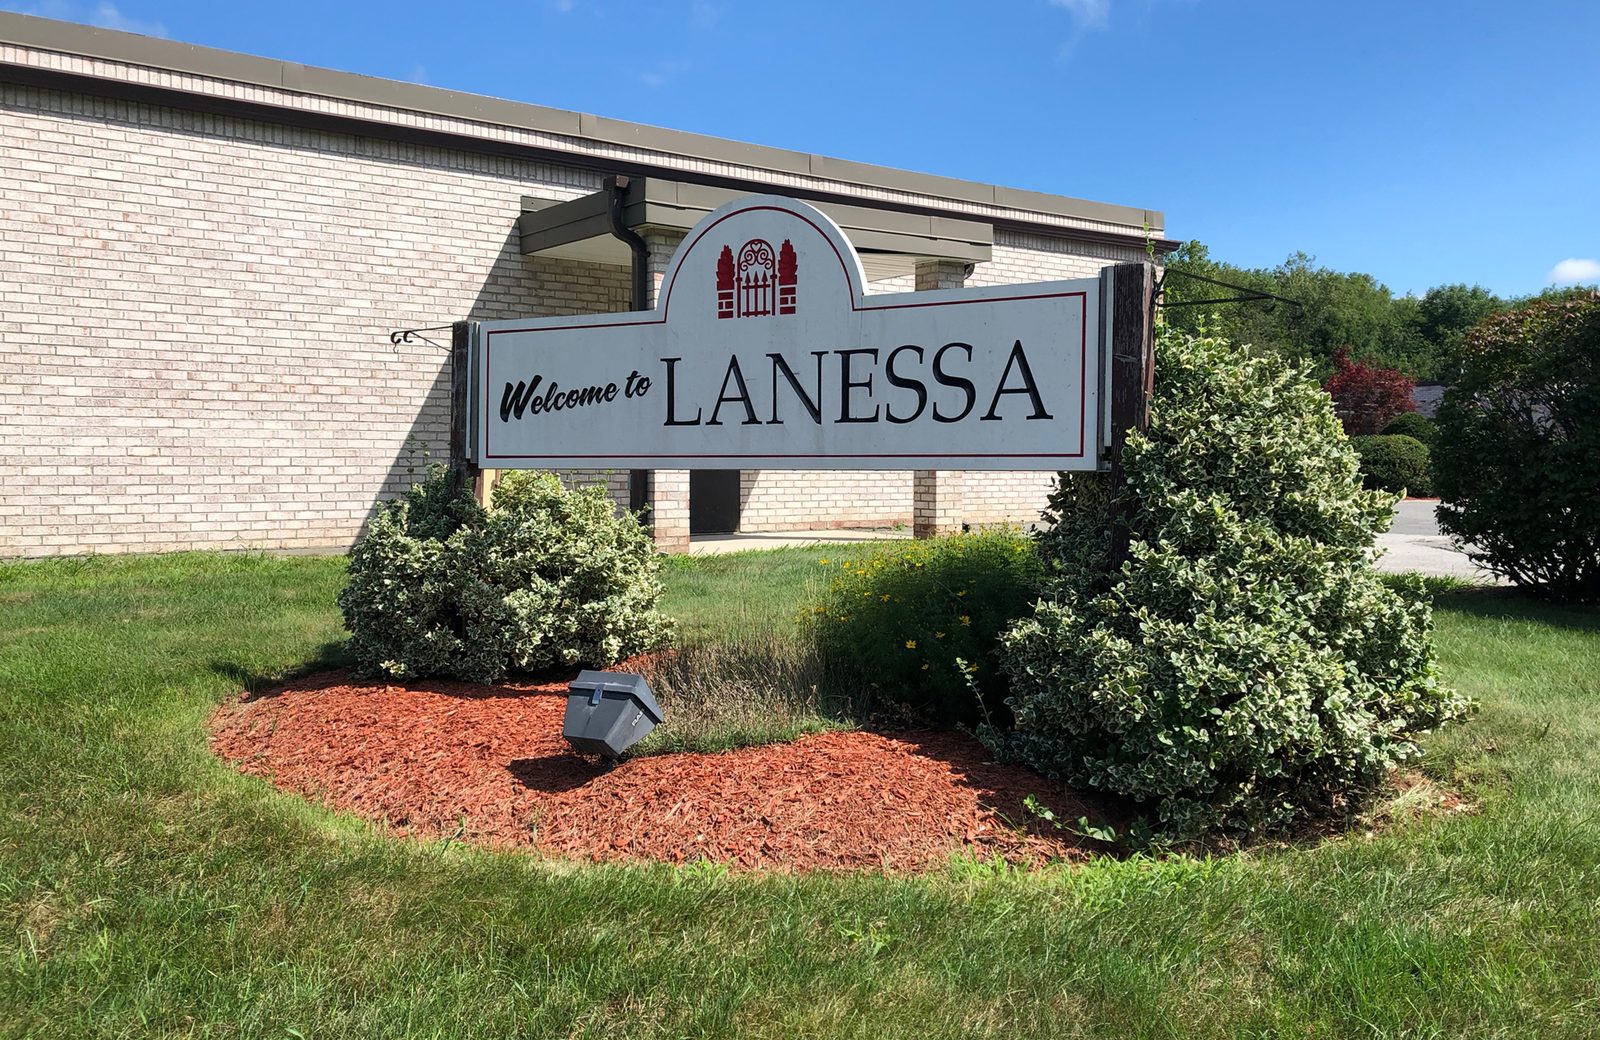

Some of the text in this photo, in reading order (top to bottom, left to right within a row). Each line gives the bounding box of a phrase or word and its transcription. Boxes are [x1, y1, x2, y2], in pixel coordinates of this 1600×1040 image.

[500, 339, 1054, 426] Welcome to LANESSA
